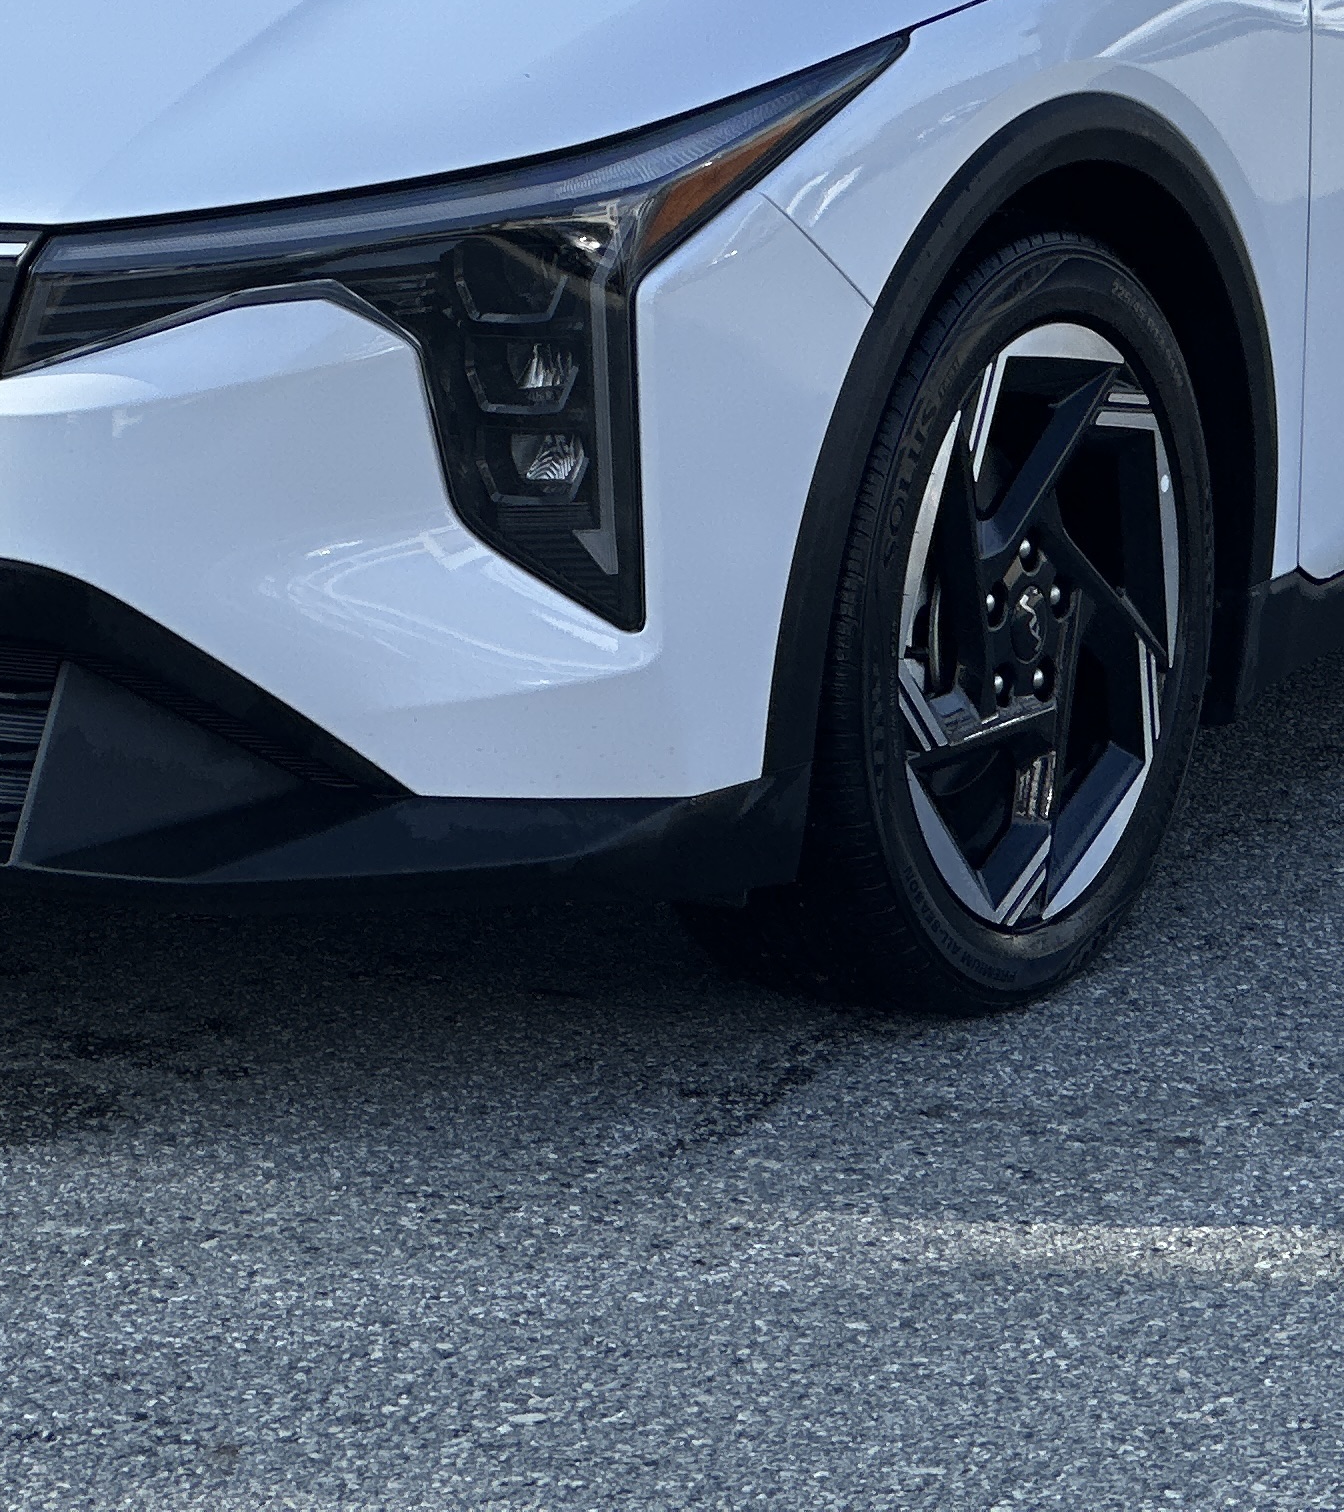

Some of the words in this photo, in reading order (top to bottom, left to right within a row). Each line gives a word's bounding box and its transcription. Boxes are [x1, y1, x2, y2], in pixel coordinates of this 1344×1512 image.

[882, 396, 938, 571] SOLUS
[903, 864, 963, 954] ALL-SEASON
[960, 951, 1018, 984] PREMIUM
